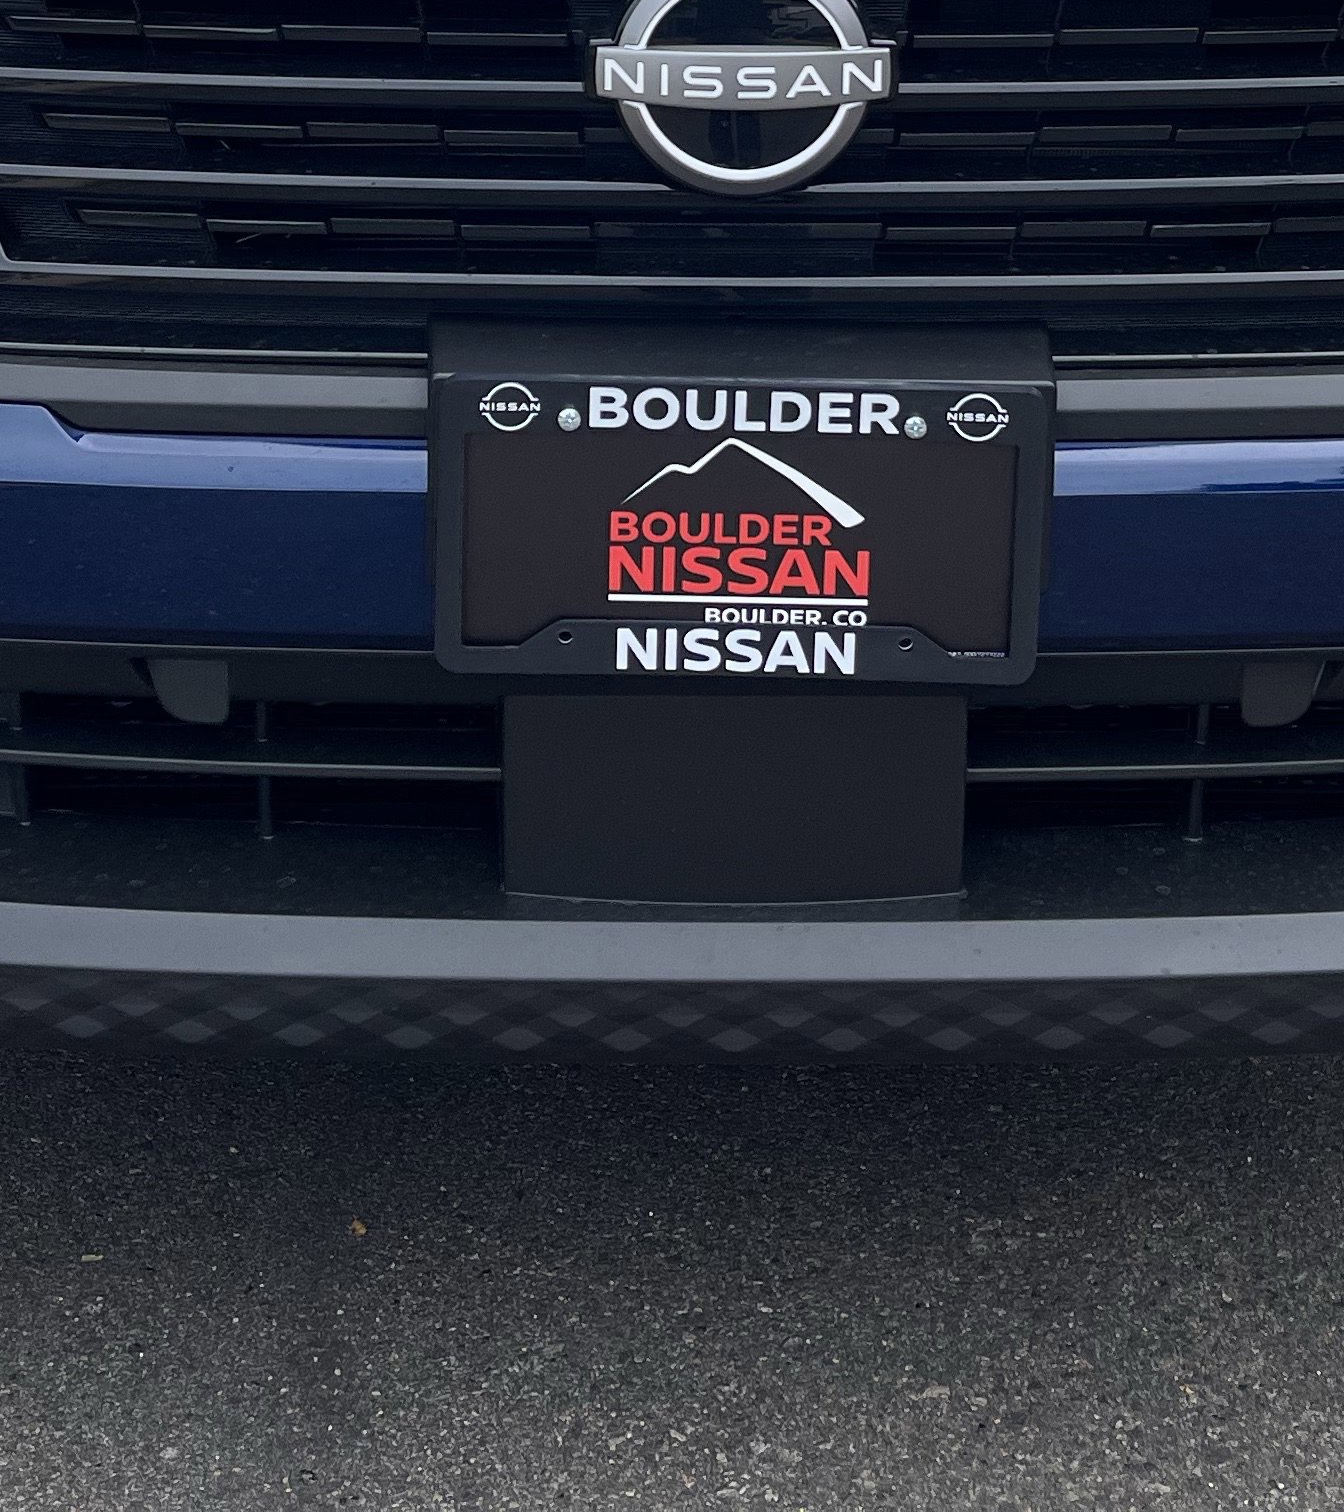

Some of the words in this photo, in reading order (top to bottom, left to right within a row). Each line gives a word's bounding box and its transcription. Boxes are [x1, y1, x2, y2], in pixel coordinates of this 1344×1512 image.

[603, 58, 883, 99] NISSAN
[479, 402, 541, 412] NISSAN
[588, 386, 900, 436] BOULDER
[946, 411, 1010, 424] NISSAN
[609, 510, 832, 547] BOULDER
[607, 545, 871, 597] NISSAN
[832, 609, 867, 627] CO
[615, 627, 856, 675] NISSAN
